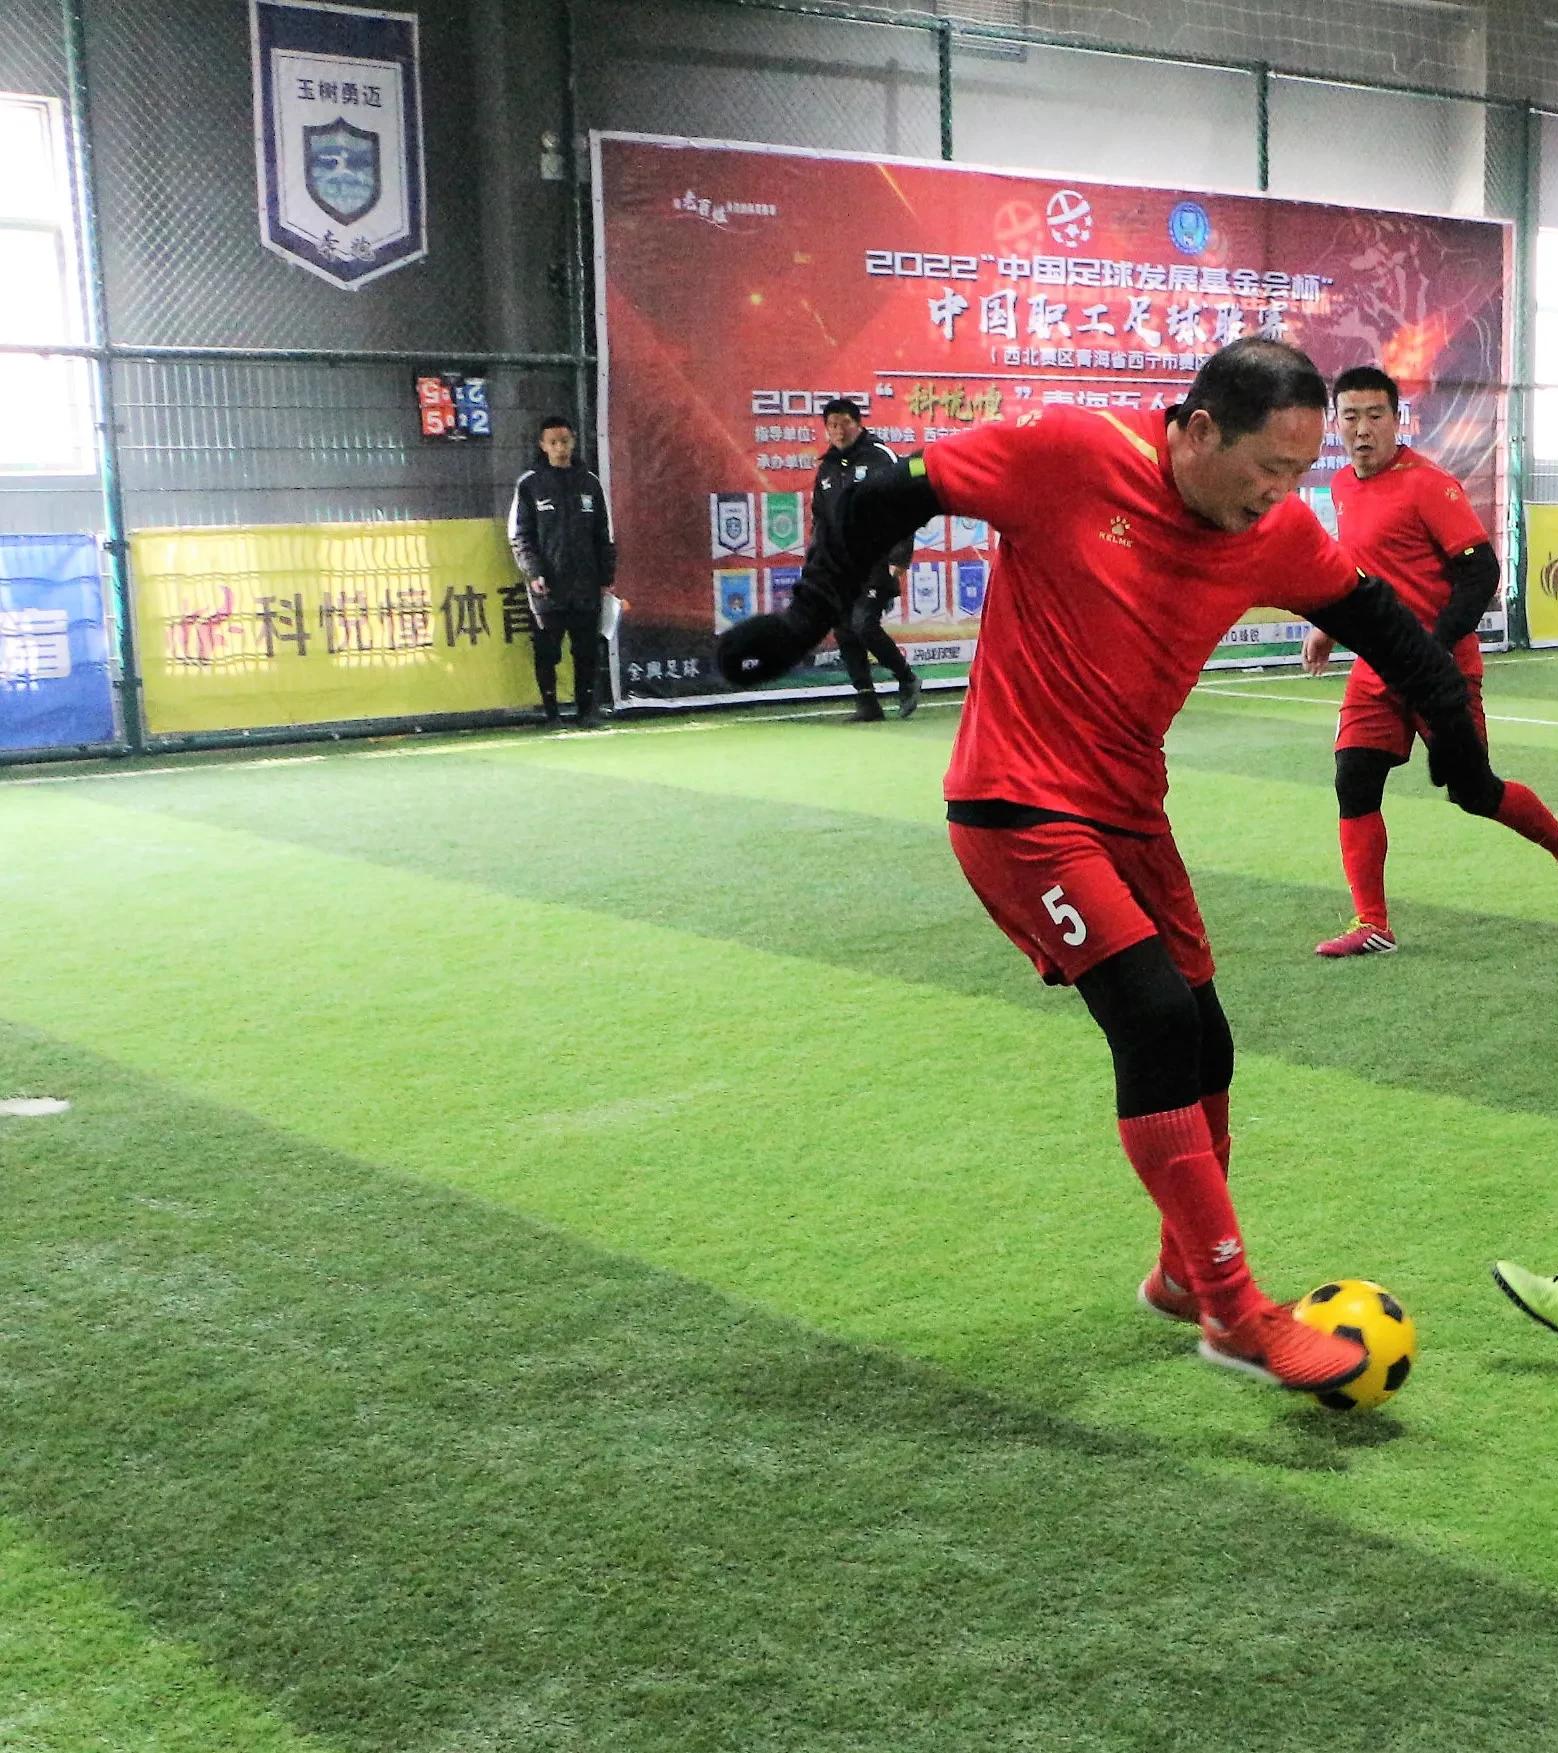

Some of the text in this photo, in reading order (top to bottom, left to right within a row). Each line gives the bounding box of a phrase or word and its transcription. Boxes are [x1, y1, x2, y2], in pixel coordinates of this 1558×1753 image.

[296, 78, 382, 108] 玉树勇迈
[928, 286, 1290, 347] 中国职工足球联赛
[1098, 530, 1133, 548] KELME
[256, 583, 536, 657] 科悦憧体育
[1041, 884, 1088, 946] 5
